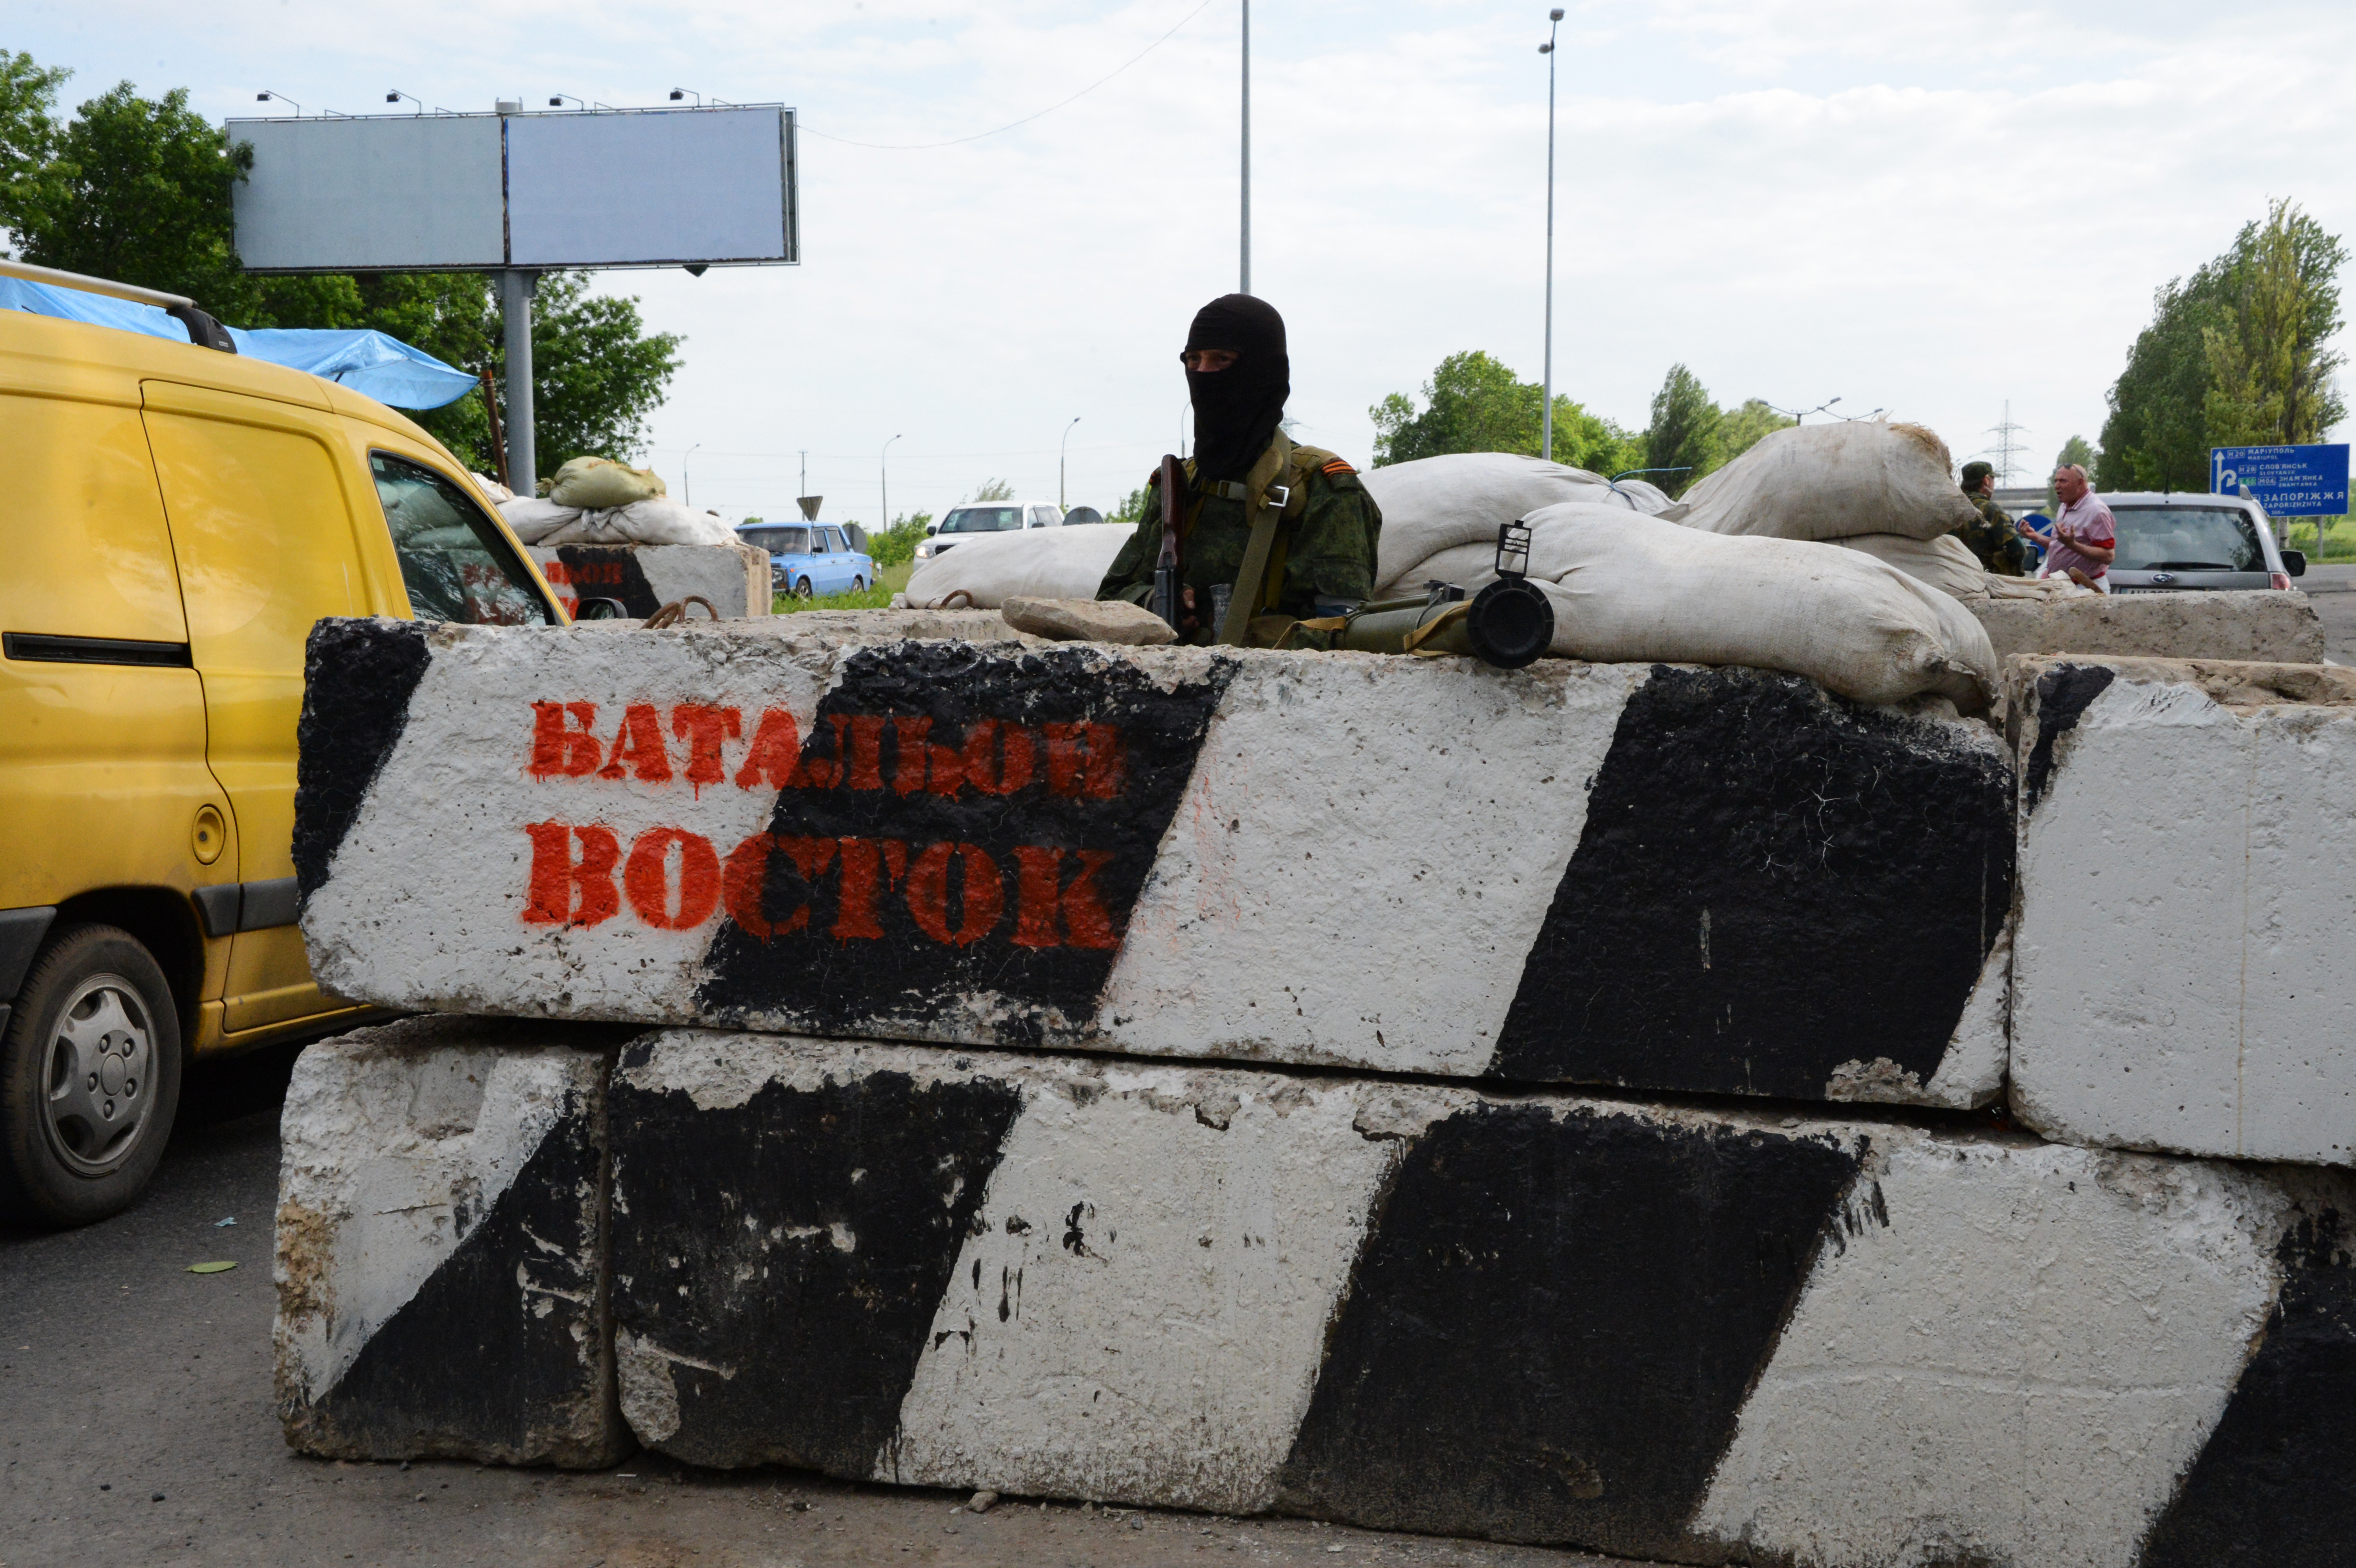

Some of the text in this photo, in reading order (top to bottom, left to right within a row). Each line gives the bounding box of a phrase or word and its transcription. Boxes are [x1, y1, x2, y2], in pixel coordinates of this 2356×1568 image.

[2264, 492, 2344, 501] ЗАПОРІЖЖЯ
[528, 699, 1121, 799] БАТАЛЬОН
[523, 819, 1120, 949] ВОСТОК
